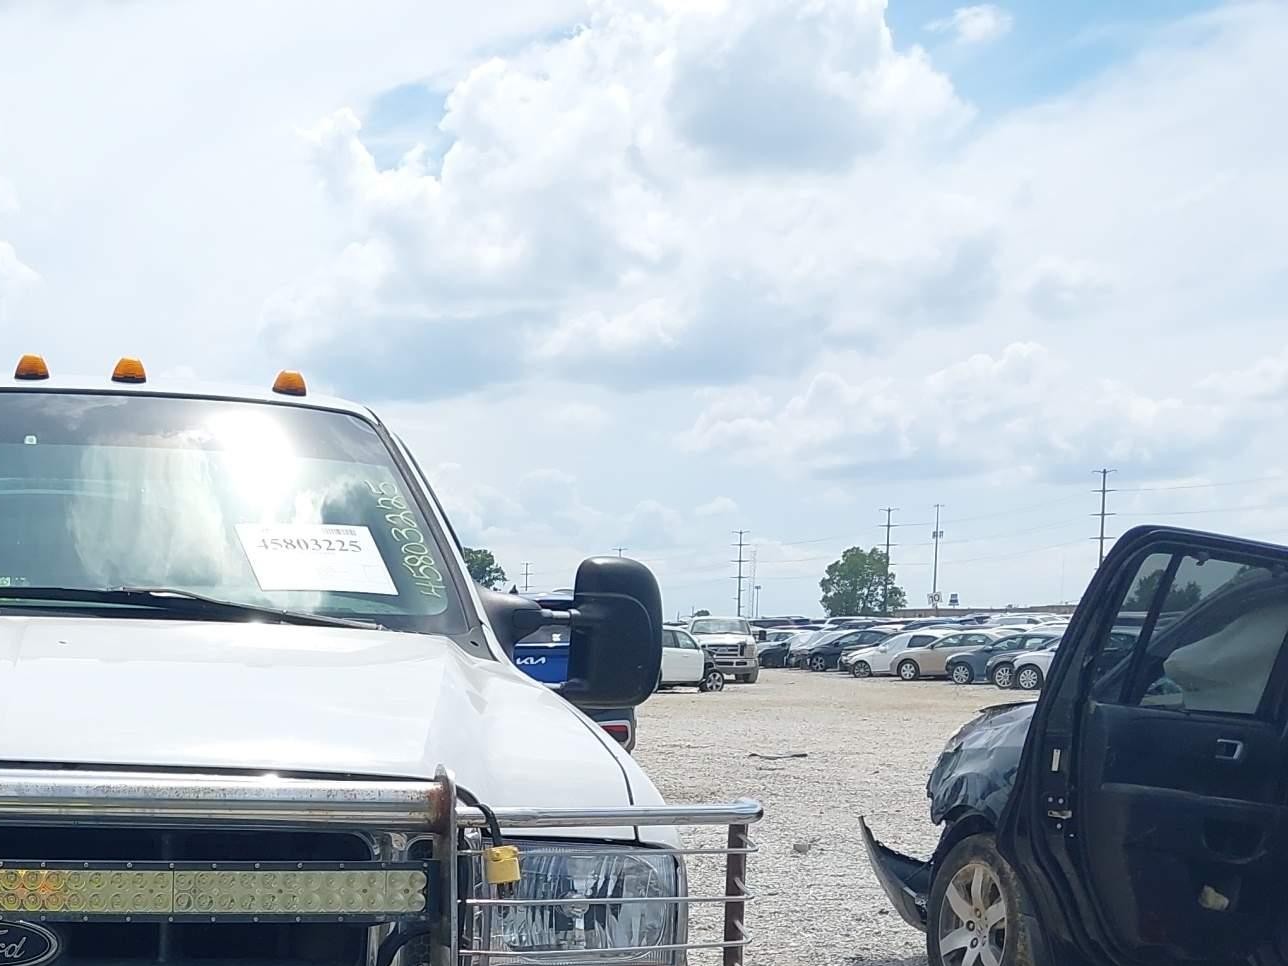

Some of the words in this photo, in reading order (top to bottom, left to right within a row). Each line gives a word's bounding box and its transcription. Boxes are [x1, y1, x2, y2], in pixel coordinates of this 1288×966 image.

[256, 537, 362, 553] 45803225
[364, 480, 446, 598] 45803225
[516, 656, 546, 665] KIA
